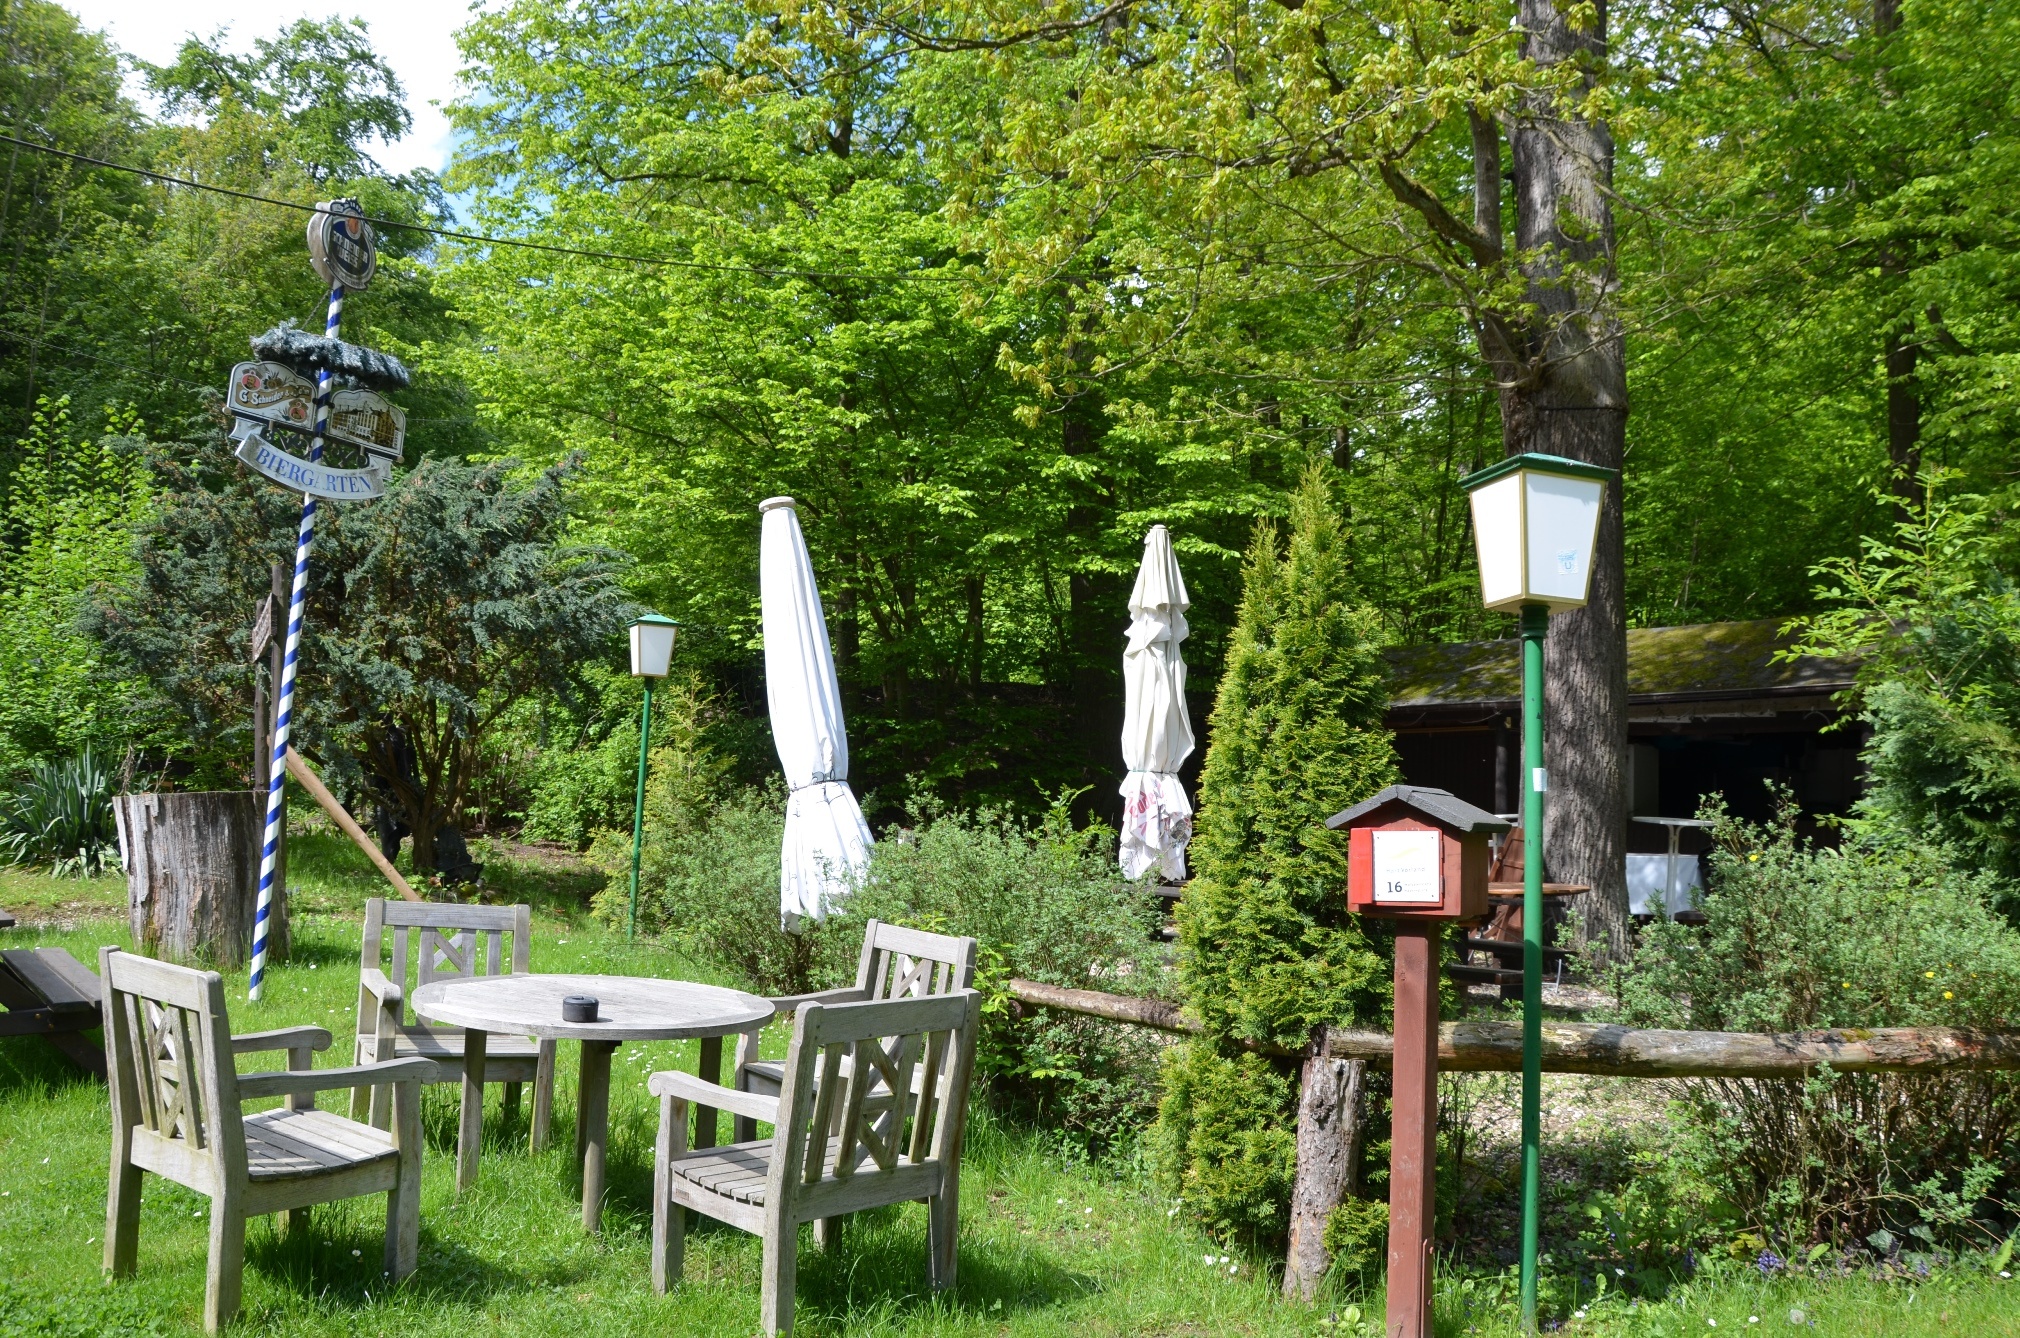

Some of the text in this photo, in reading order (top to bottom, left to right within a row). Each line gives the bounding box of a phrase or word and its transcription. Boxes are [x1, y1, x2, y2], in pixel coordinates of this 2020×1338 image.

[251, 391, 284, 405] Schneider
[255, 447, 372, 493] BIERGARTEN
[1387, 881, 1403, 893] 16
